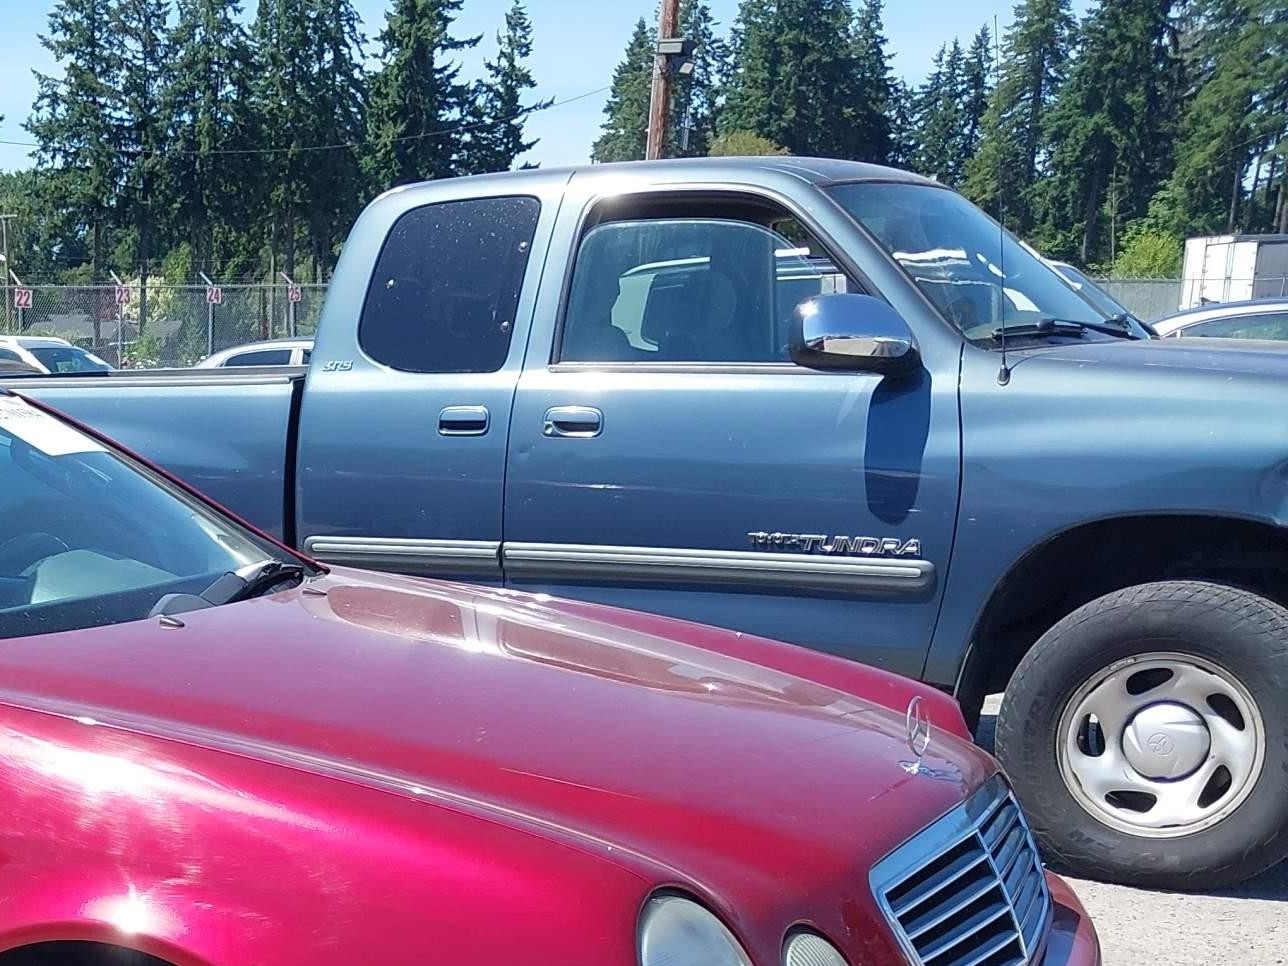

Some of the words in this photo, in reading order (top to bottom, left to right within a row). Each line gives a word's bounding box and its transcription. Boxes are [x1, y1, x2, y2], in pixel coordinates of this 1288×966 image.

[16, 290, 30, 306] 22
[116, 288, 130, 304] 23
[208, 287, 220, 302] 24
[289, 287, 300, 301] 25
[798, 534, 921, 556] TUNDRA
